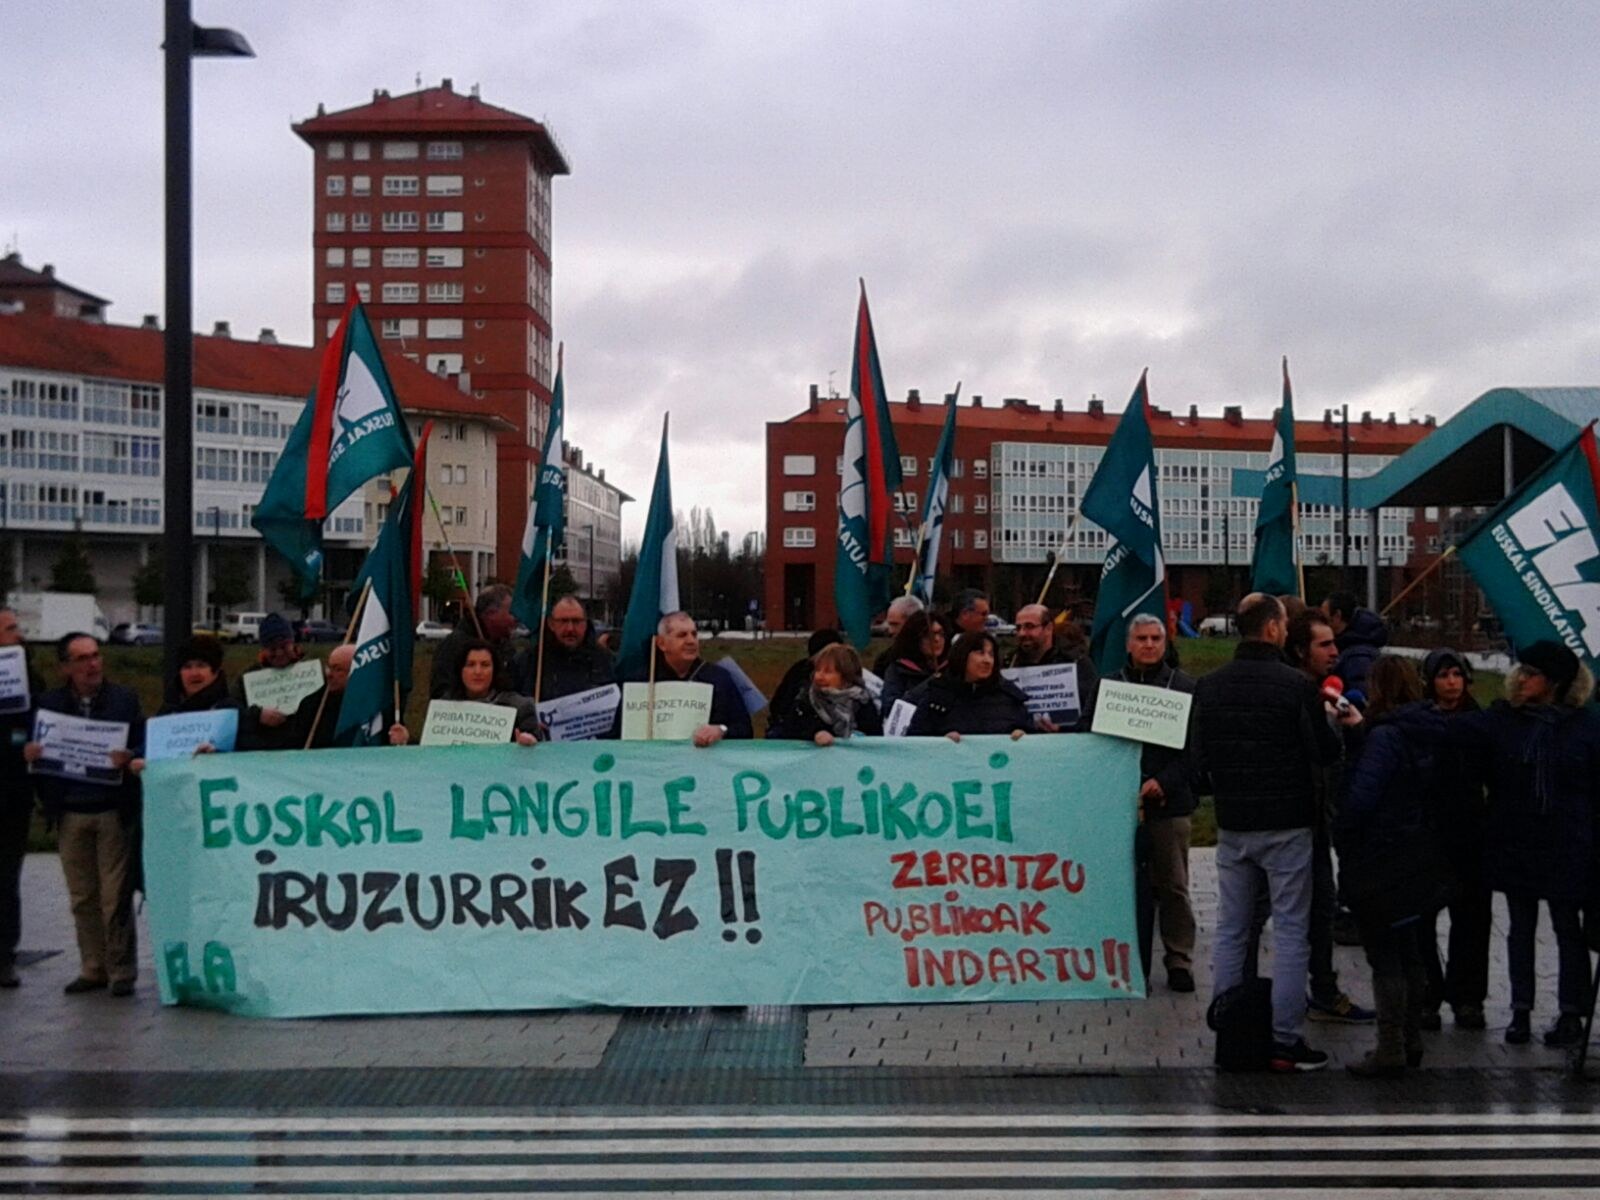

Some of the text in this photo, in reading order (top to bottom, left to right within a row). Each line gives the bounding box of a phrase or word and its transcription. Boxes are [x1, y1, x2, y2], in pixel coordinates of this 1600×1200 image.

[1491, 524, 1529, 574] EUSKAL
[200, 752, 1014, 849] EUSKAL LANGILE PUBLIKOEI
[254, 849, 591, 932] IRUZURRIK
[890, 850, 1086, 894] ZERBITZU
[863, 891, 1052, 938] PUBLIKOAK
